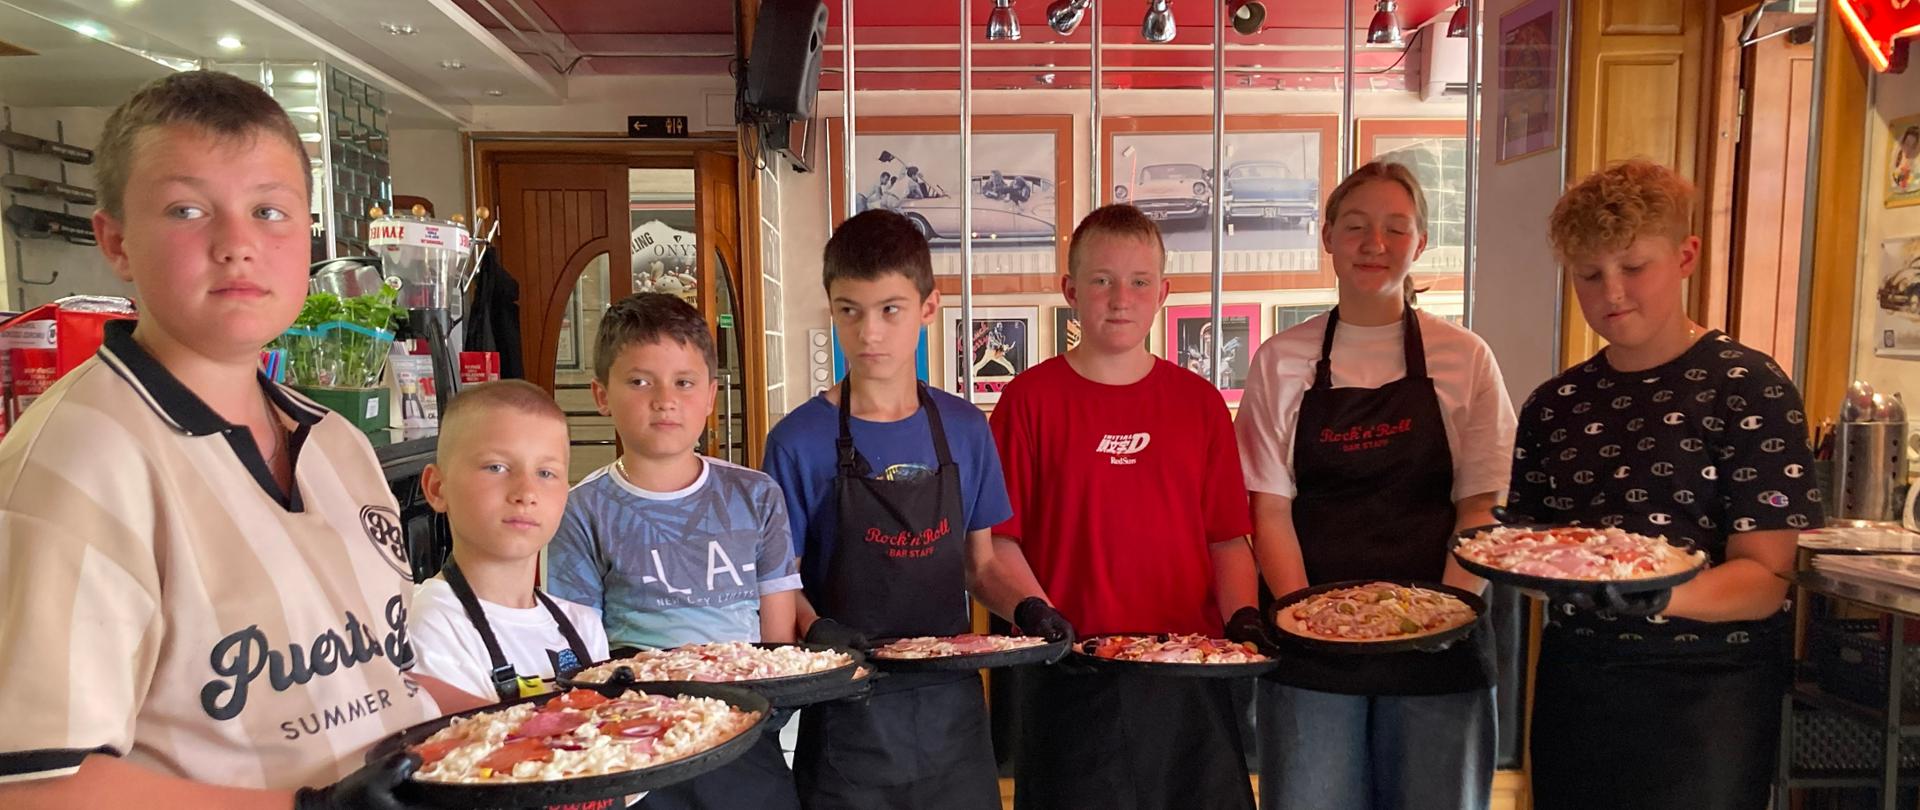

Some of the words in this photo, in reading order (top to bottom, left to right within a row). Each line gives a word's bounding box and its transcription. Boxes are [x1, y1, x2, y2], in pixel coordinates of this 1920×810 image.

[631, 232, 654, 255] LING
[889, 548, 907, 557] BAR
[908, 546, 935, 557] STAFF
[280, 689, 393, 740] SUMMER
